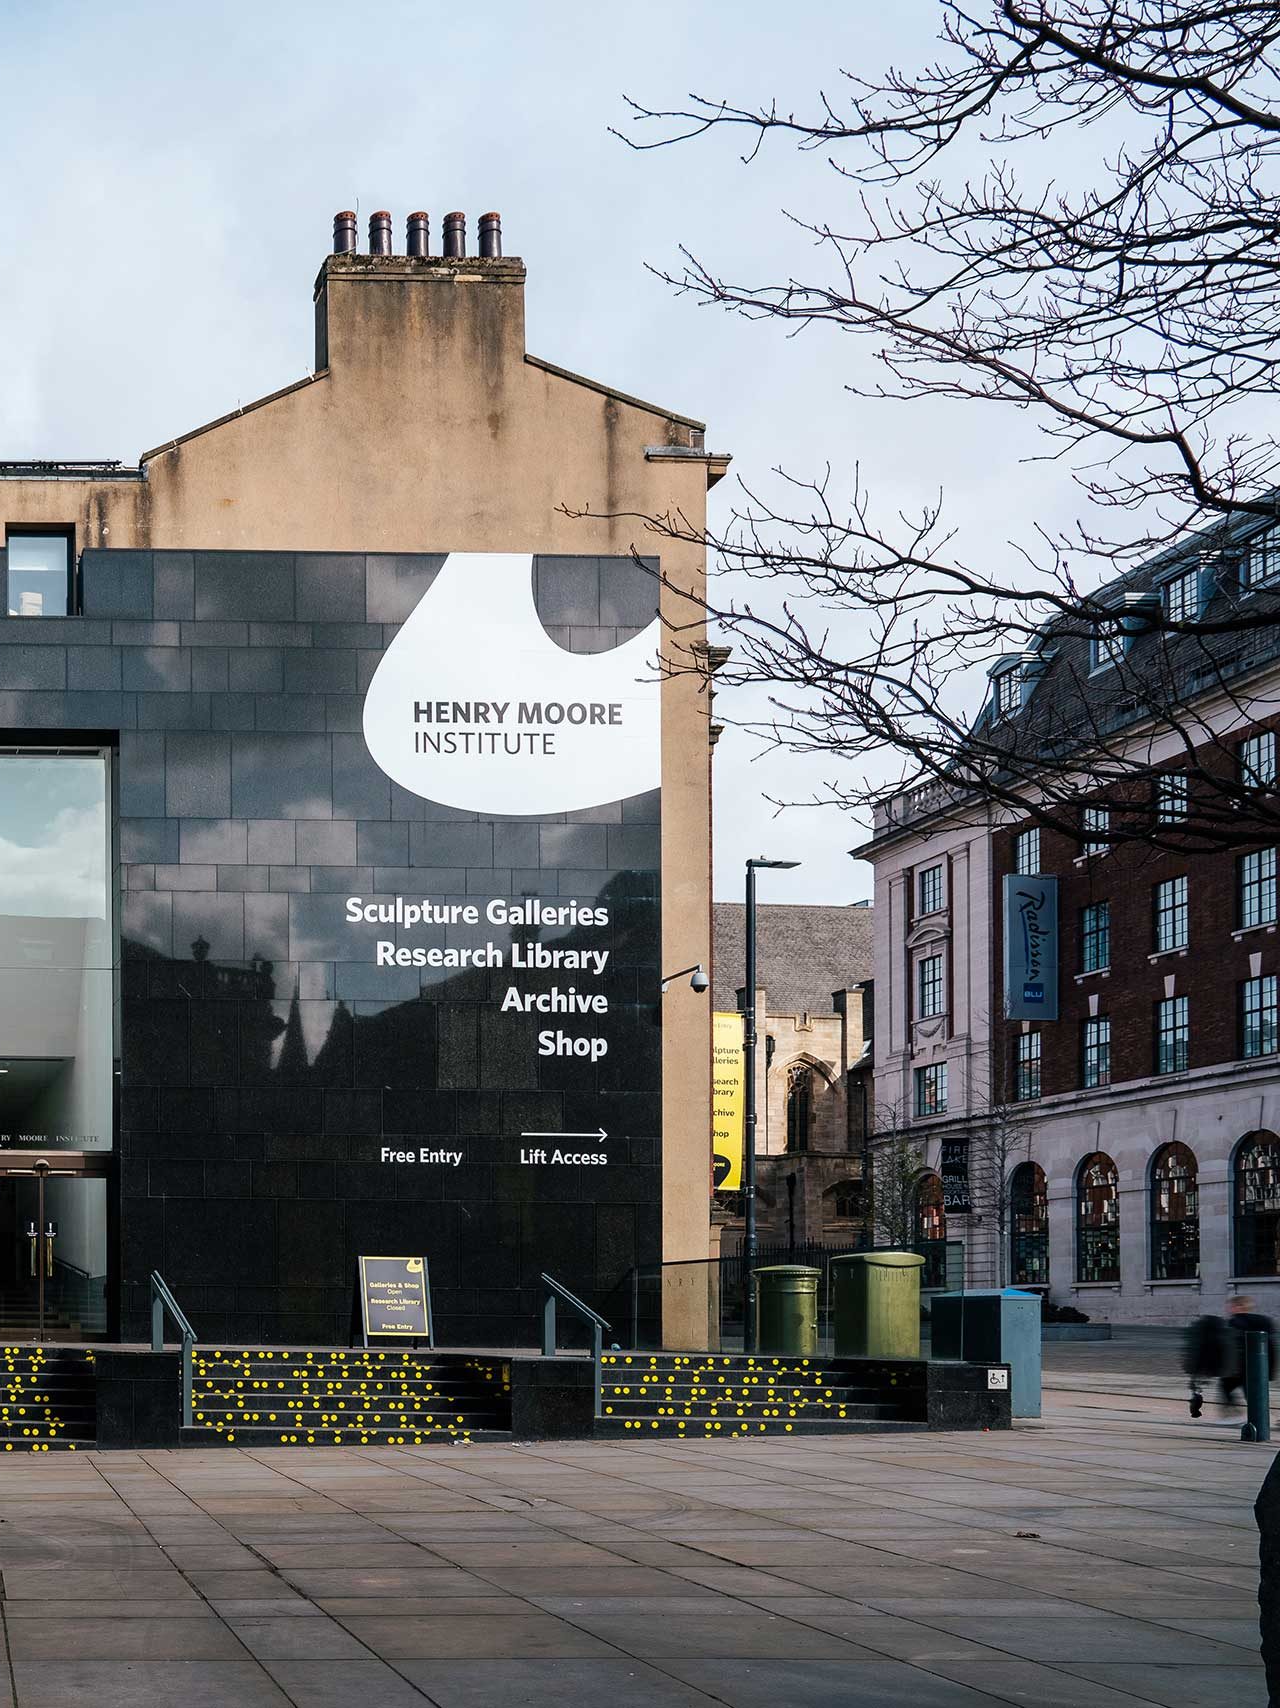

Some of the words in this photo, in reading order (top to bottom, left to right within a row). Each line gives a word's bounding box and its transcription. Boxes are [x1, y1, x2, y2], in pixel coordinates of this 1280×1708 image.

[414, 701, 510, 724] HENRY
[518, 702, 622, 725] MOORE
[415, 731, 556, 755] INSTITUTE
[346, 897, 478, 929] Sculpture
[487, 899, 609, 926] Galleries
[1016, 891, 1051, 981] Radisson
[376, 940, 503, 968] Research
[511, 942, 609, 975] Library
[1024, 990, 1043, 998] BLU
[501, 986, 608, 1014] Archive
[538, 1031, 608, 1062] Shop
[713, 1046, 740, 1055] lpture
[713, 1056, 739, 1065] lleries
[713, 1088, 735, 1097] brary
[713, 1108, 735, 1117] chive
[18, 1134, 48, 1142] MOORE
[713, 1130, 730, 1139] hop
[941, 1145, 968, 1154] FIRE
[381, 1147, 416, 1163] Free
[419, 1147, 463, 1167] Entry
[520, 1148, 547, 1165] Lift
[550, 1149, 608, 1165] Access
[942, 1175, 968, 1184] GRILL
[943, 1195, 971, 1206] BAR
[399, 1298, 421, 1306] Library
